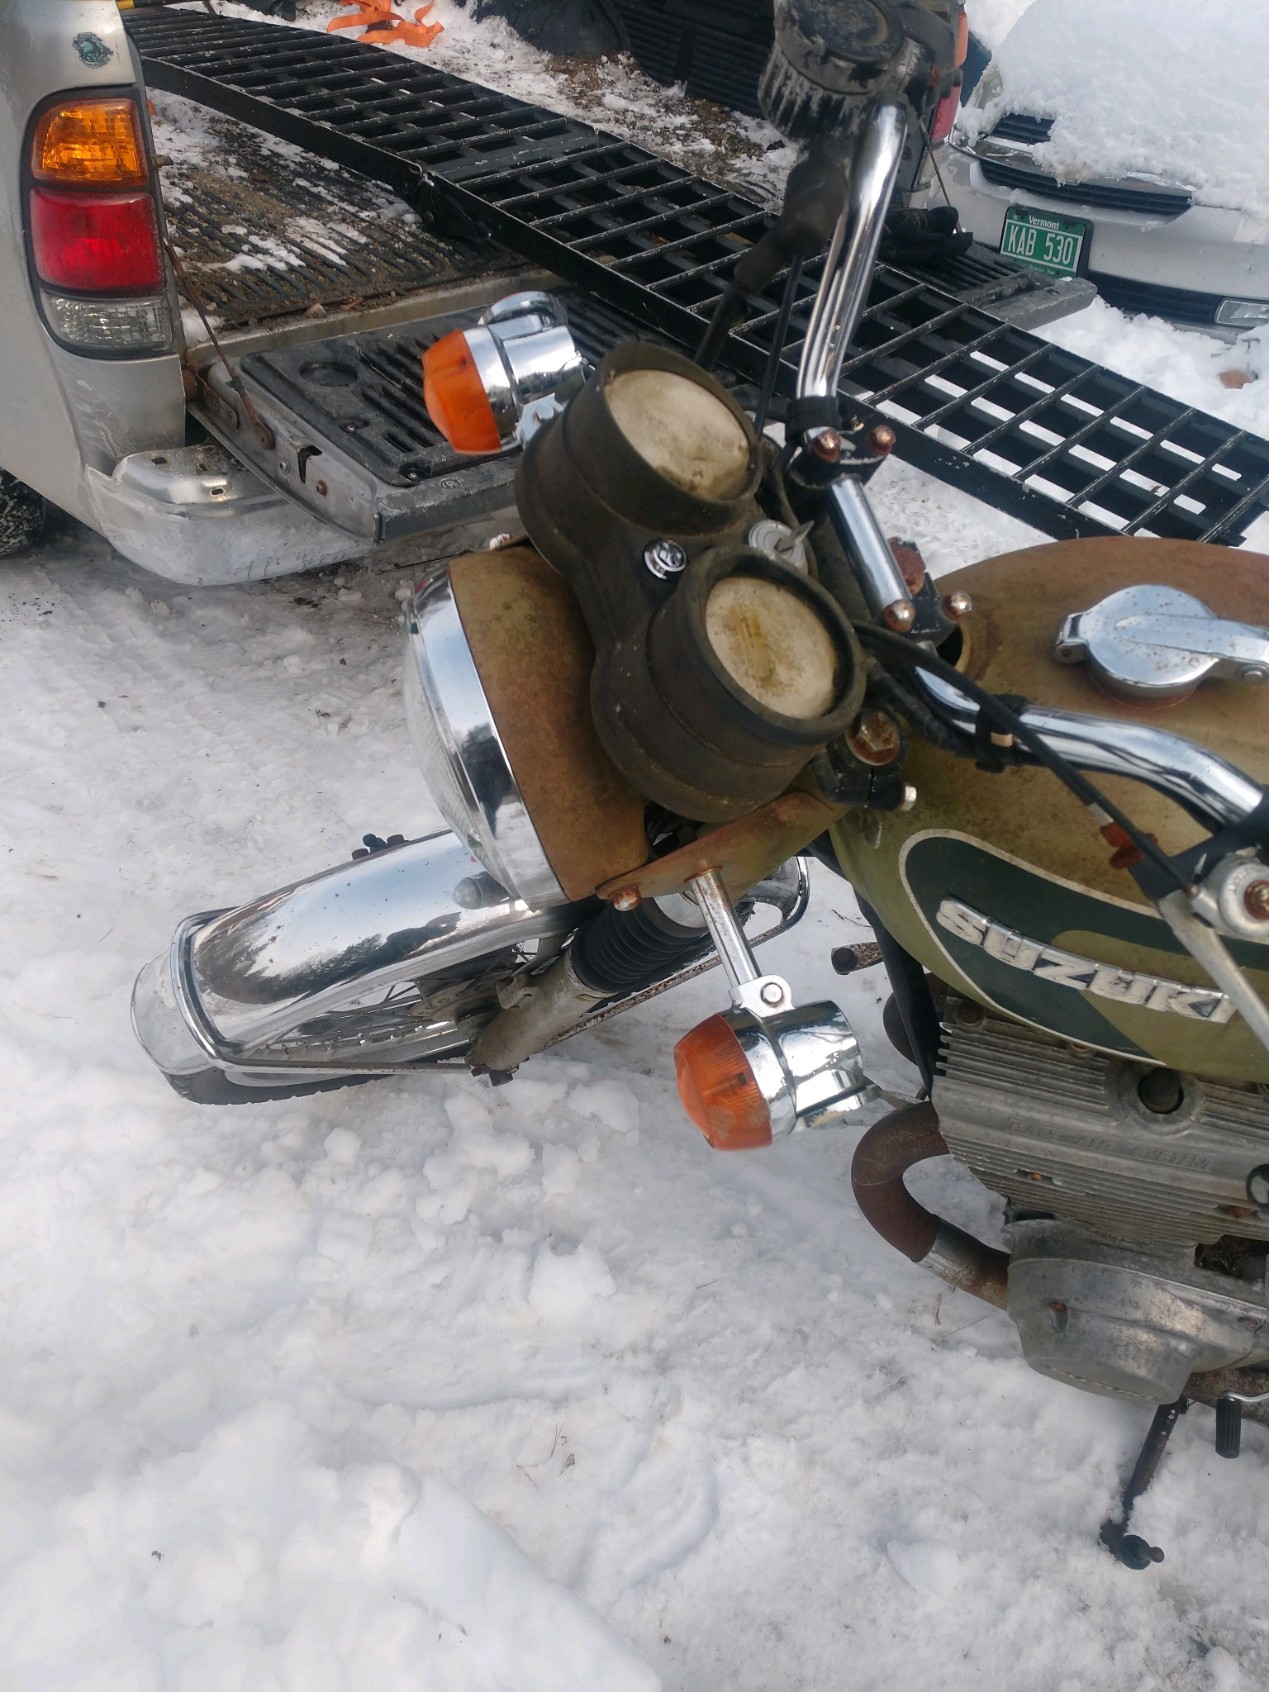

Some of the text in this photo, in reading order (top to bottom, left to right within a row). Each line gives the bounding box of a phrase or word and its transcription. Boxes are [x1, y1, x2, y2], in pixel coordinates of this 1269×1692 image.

[1029, 215, 1060, 230] Vermont
[1008, 226, 1073, 264] KAB 530
[936, 899, 1237, 1024] SUZUKI
